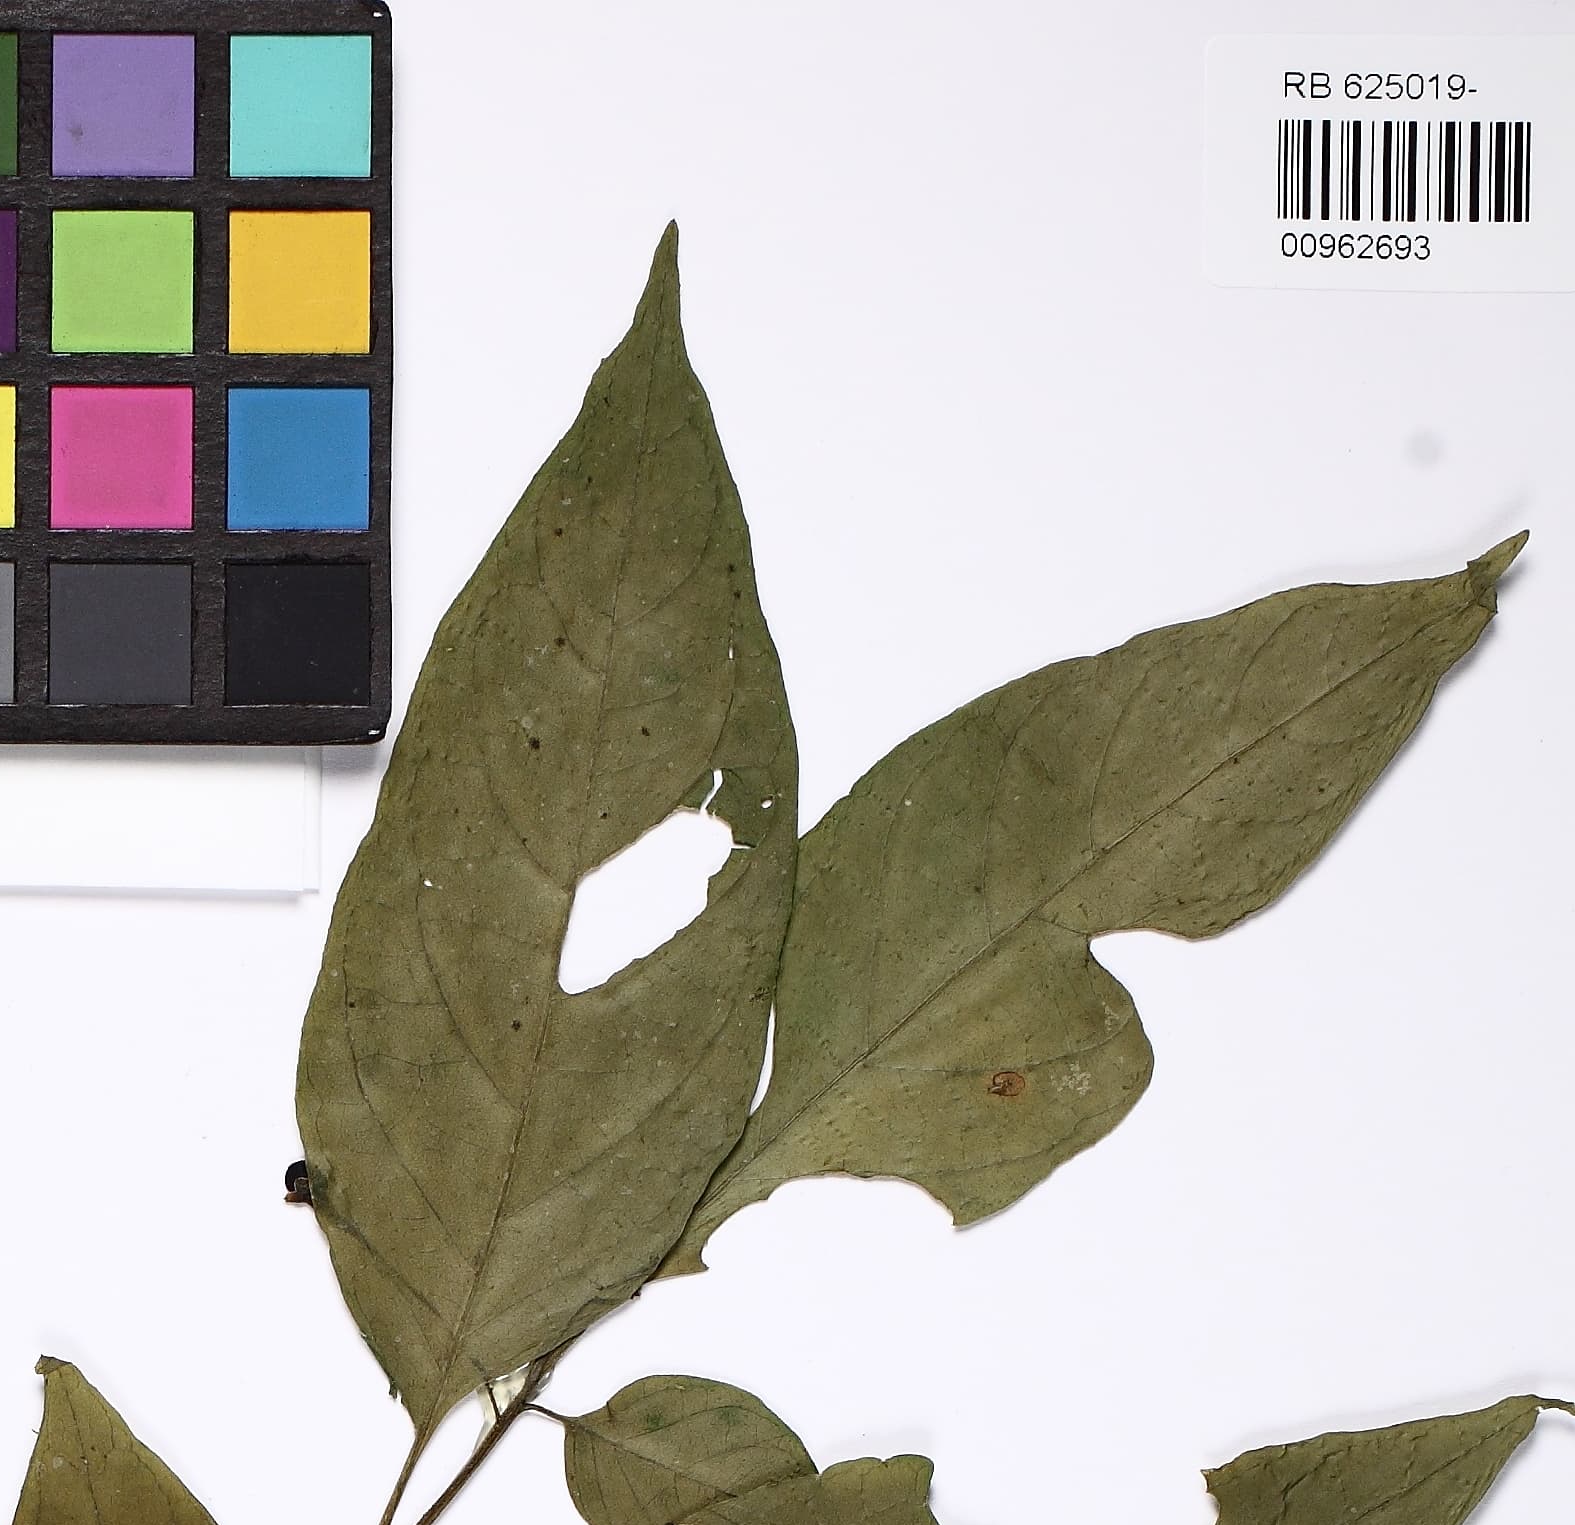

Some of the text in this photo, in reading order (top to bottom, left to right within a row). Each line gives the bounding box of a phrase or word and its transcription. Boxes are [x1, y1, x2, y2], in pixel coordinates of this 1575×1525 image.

[1285, 72, 1477, 100] RB 625019-
[1282, 233, 1430, 260] 00962693
